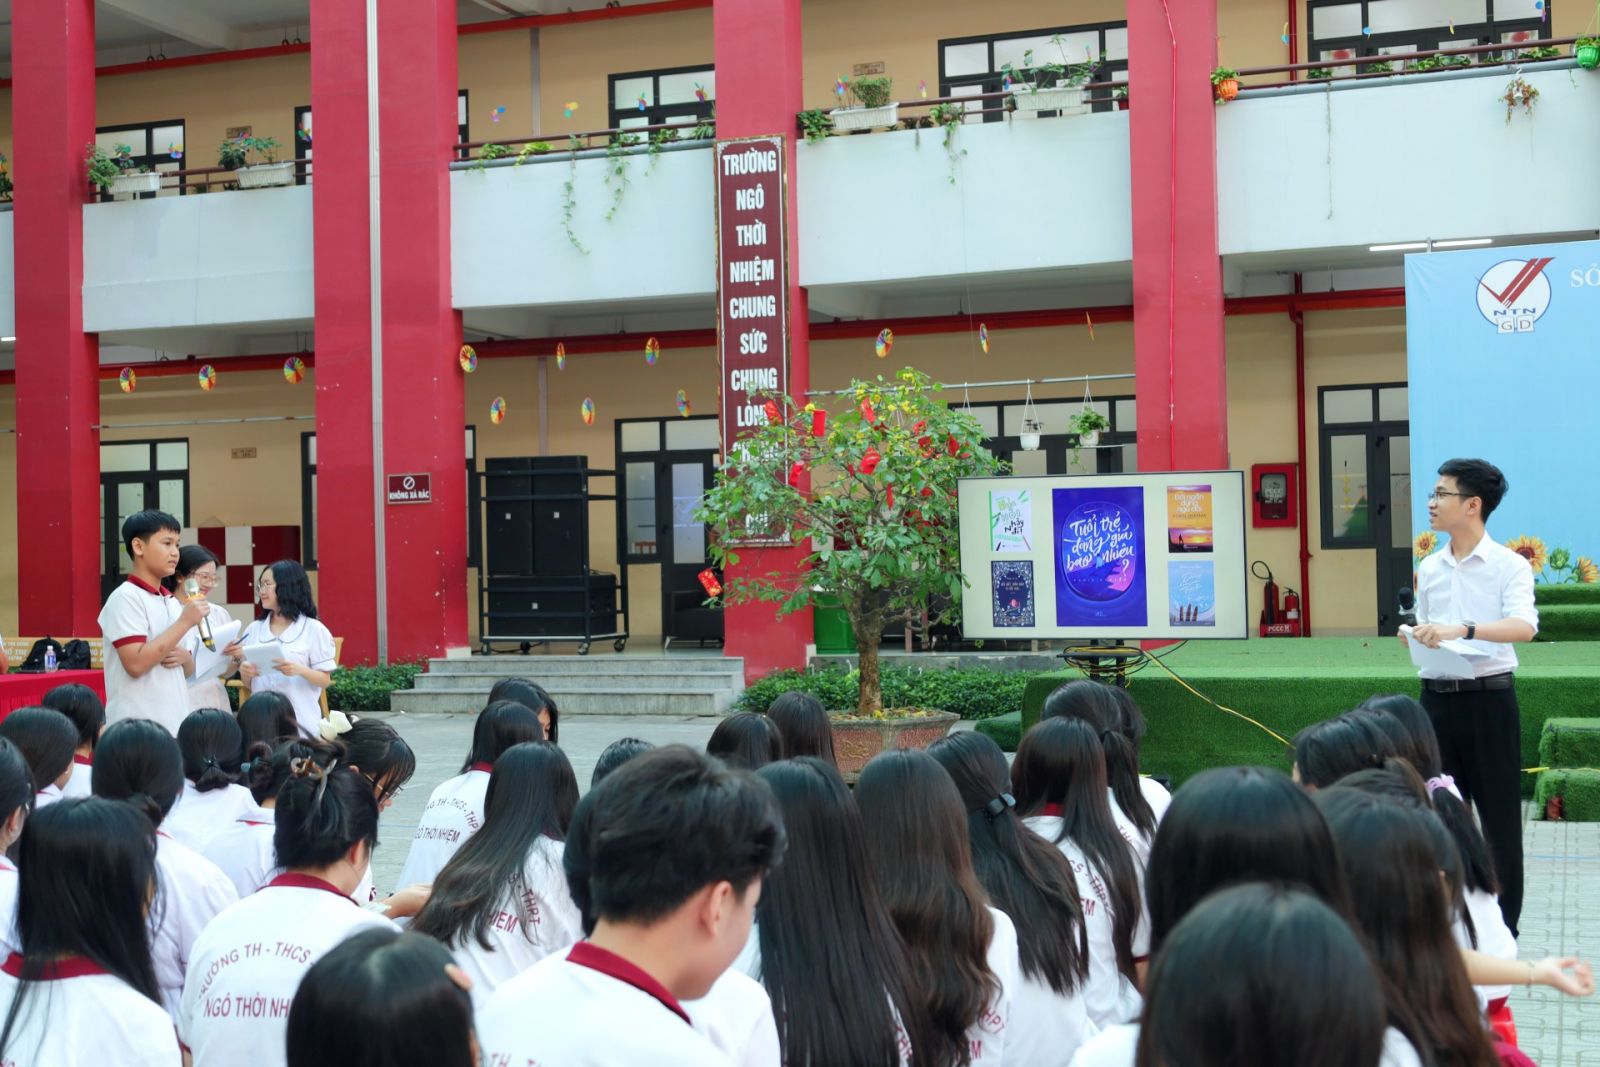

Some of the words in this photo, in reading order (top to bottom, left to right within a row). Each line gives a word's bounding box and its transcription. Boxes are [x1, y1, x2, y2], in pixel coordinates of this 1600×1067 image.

[722, 147, 777, 176] TRƯỜNG
[736, 183, 765, 211] NGÔ
[736, 219, 767, 246] THỜI
[730, 255, 775, 286] NHIỆM
[729, 295, 776, 319] CHUNG
[1493, 307, 1536, 316] NTN
[739, 328, 768, 355] SỨC
[731, 367, 778, 391] CHUNG
[737, 400, 768, 427] LÒN
[389, 490, 409, 500] KHÔNG
[418, 488, 430, 499] RÁC
[1069, 513, 1100, 537] Tuổi
[1100, 510, 1120, 532] trẻ
[1109, 523, 1132, 547] giá
[1066, 553, 1092, 572] bao
[1102, 542, 1134, 563] nhiêu
[244, 942, 262, 958] TH
[275, 942, 312, 963] THCS
[204, 991, 231, 1018] NGÔ
[236, 991, 267, 1018] THỜI
[269, 997, 291, 1018] NH
